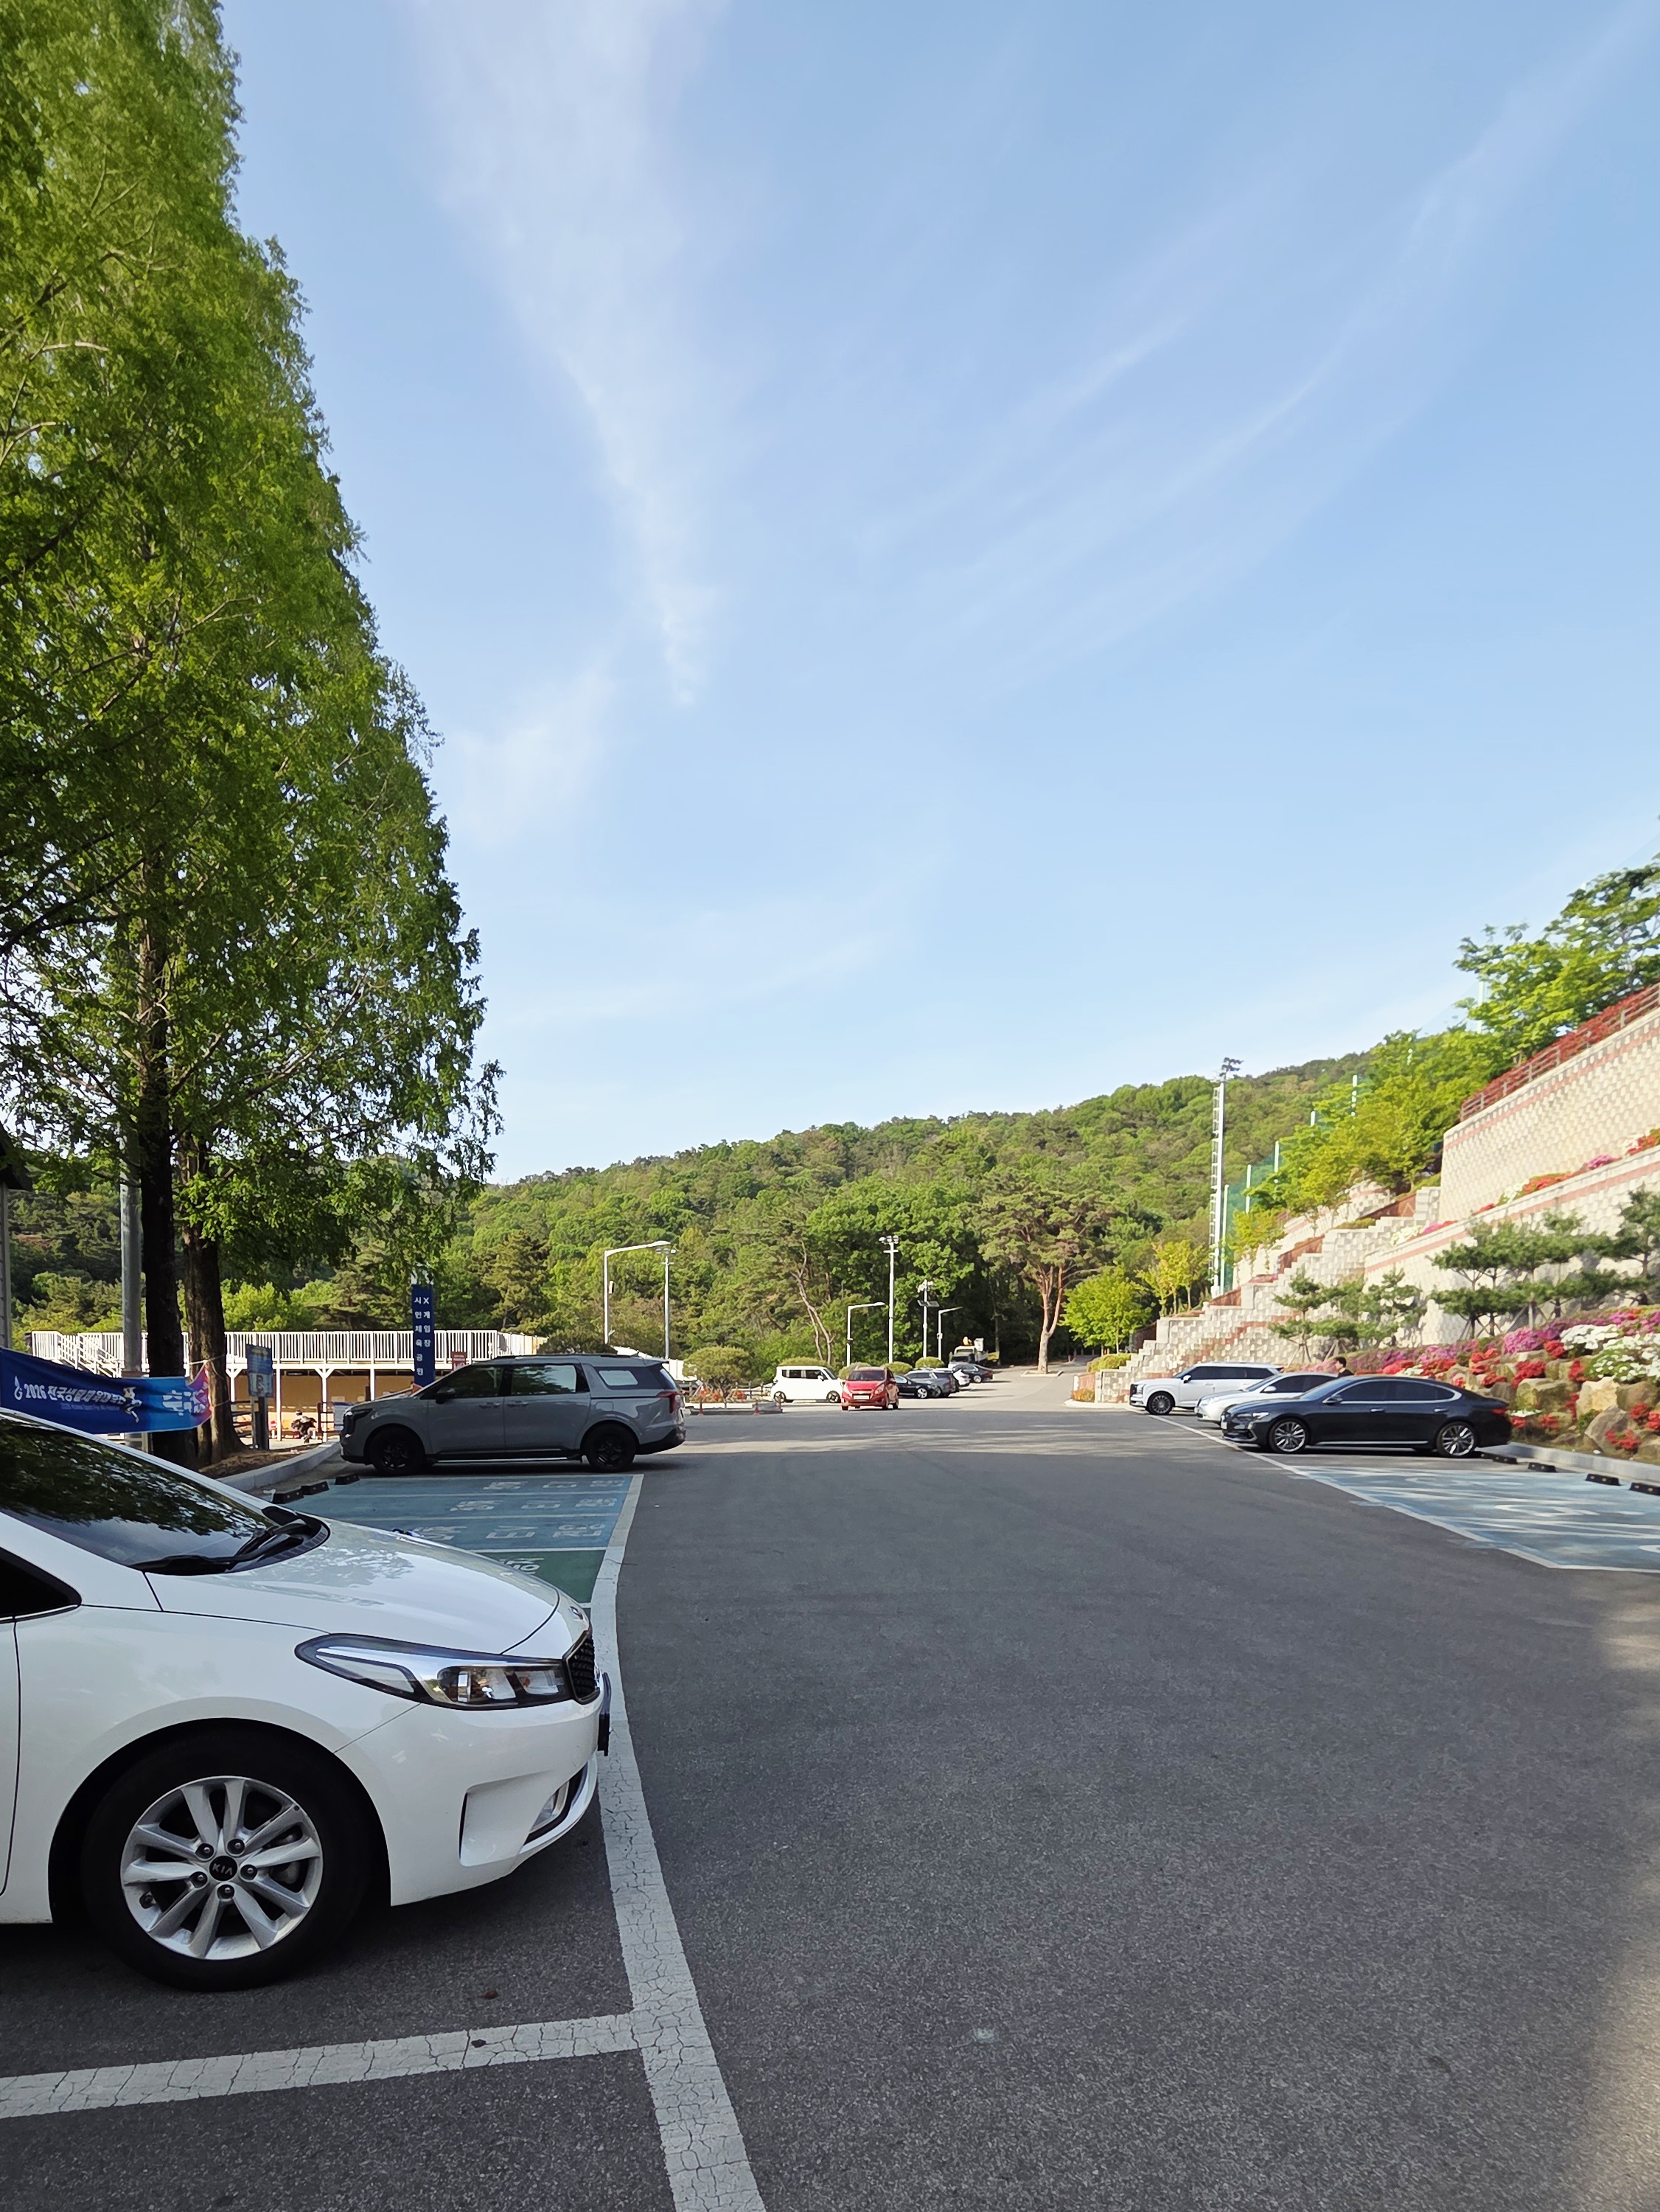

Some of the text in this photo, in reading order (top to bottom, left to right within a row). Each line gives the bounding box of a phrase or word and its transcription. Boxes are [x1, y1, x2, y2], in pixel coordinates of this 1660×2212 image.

[414, 1296, 424, 1376] 시민체육공원
[24, 1383, 47, 1399] 2026
[485, 1525, 539, 1539] EV
[212, 1863, 233, 1876] KIA
